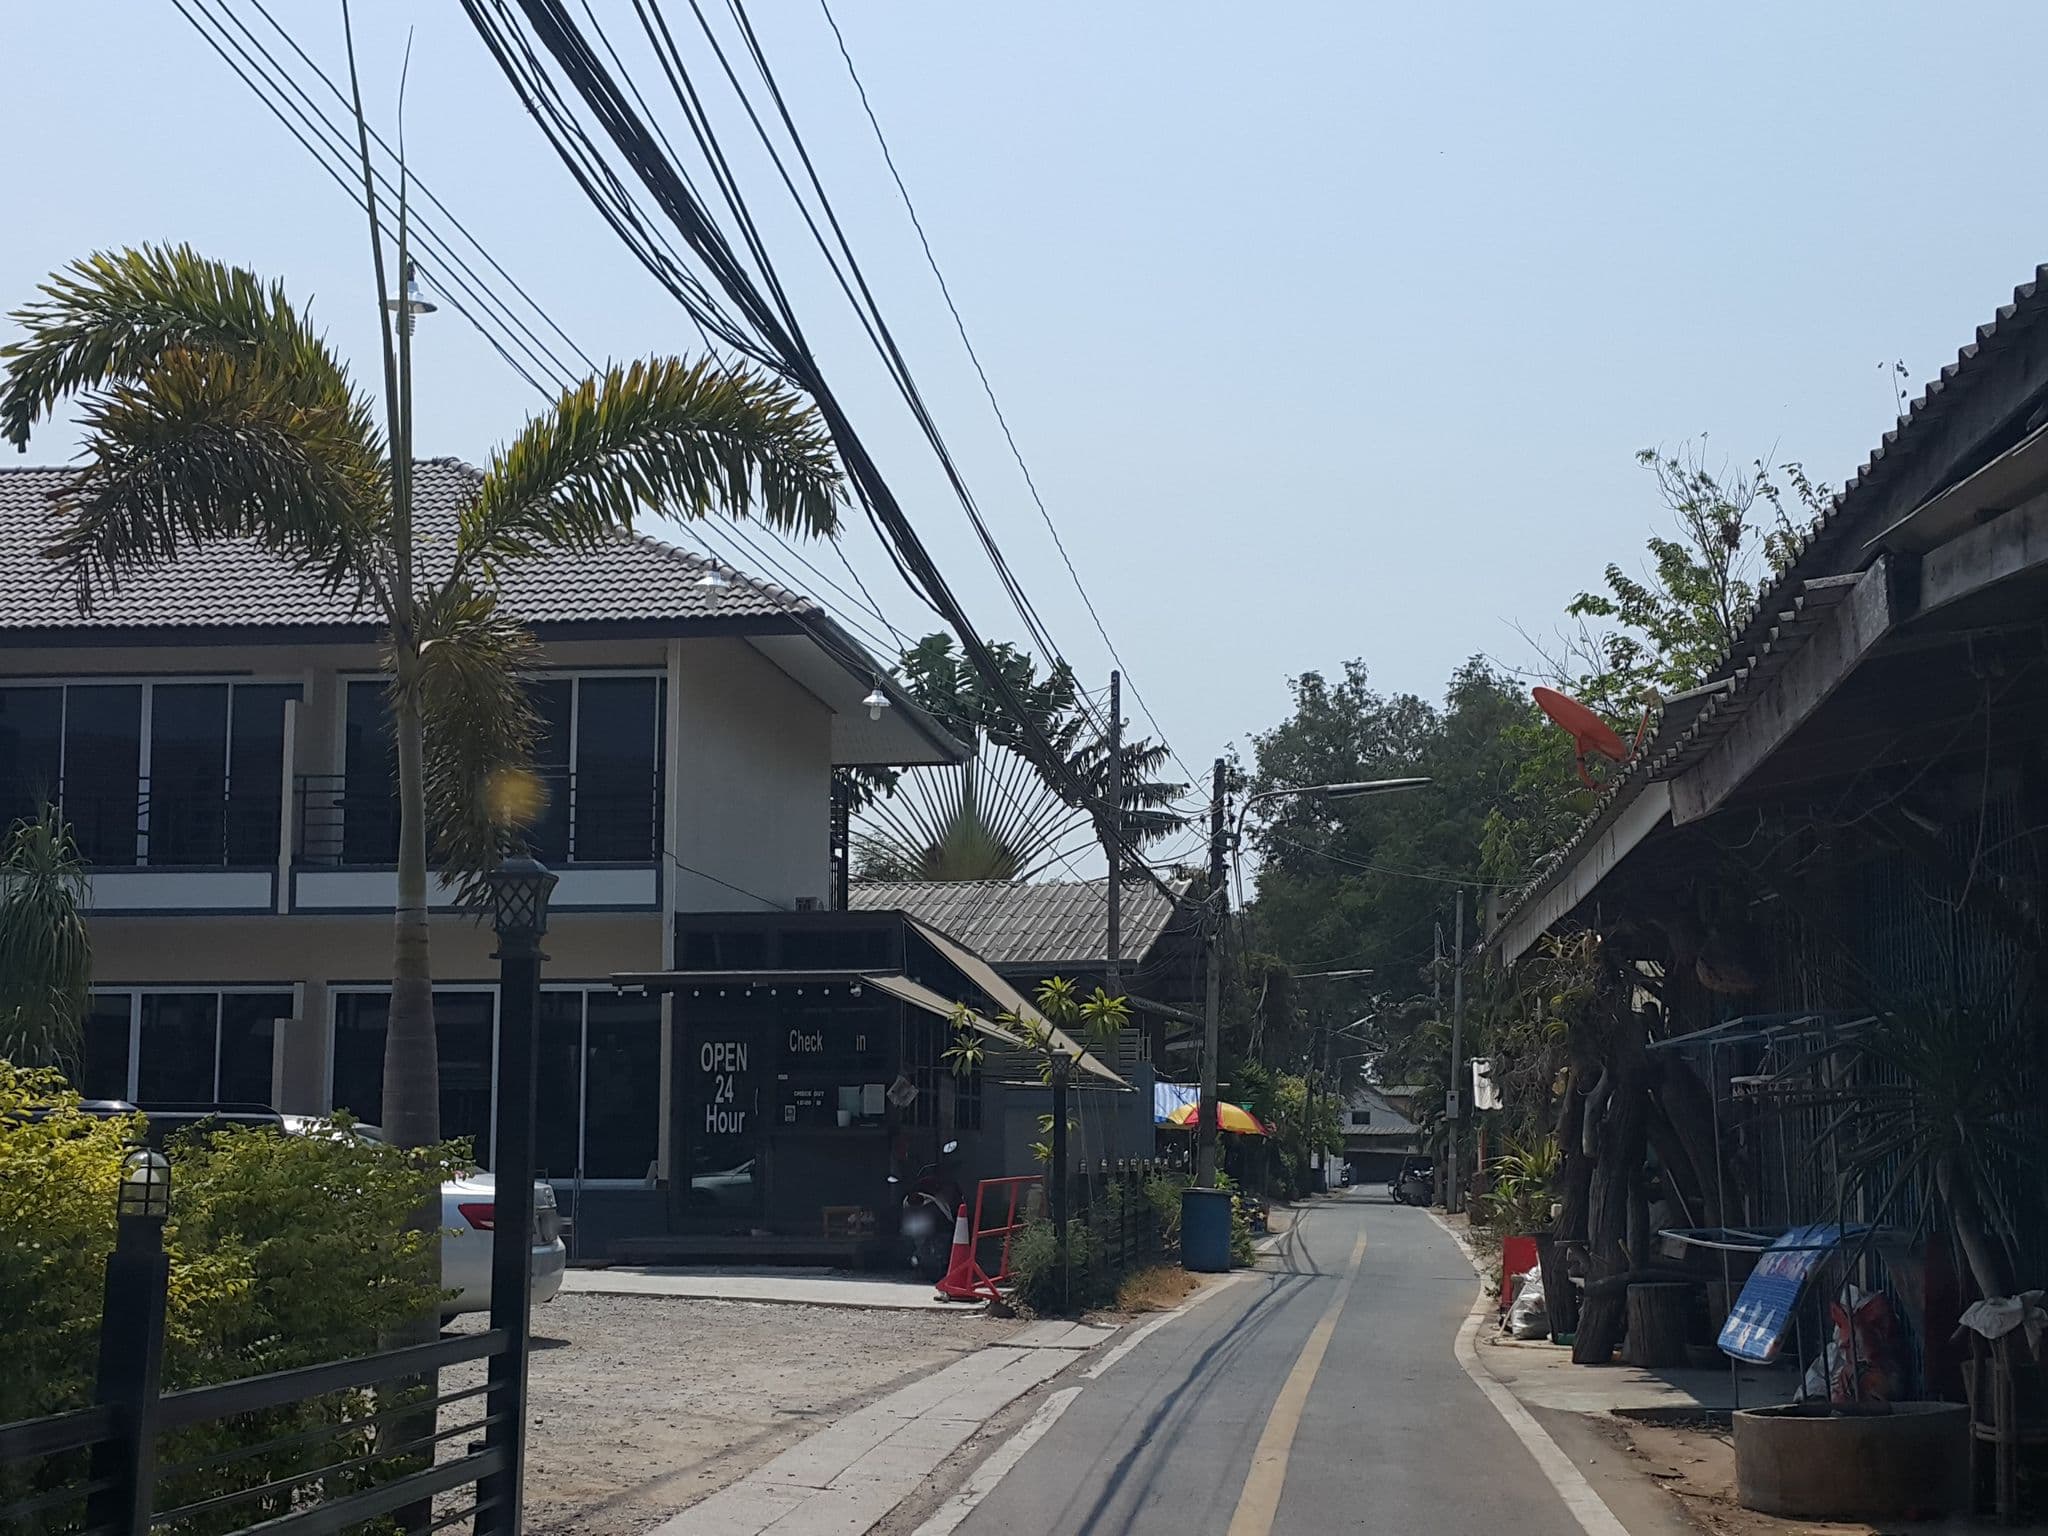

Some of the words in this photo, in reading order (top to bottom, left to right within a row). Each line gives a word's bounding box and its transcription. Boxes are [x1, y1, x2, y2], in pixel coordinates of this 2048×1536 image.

[789, 1029, 824, 1052] Check
[855, 1033, 867, 1052] in
[700, 1042, 748, 1072] OPEN
[714, 1075, 735, 1104] 24
[705, 1104, 746, 1134] Hour
